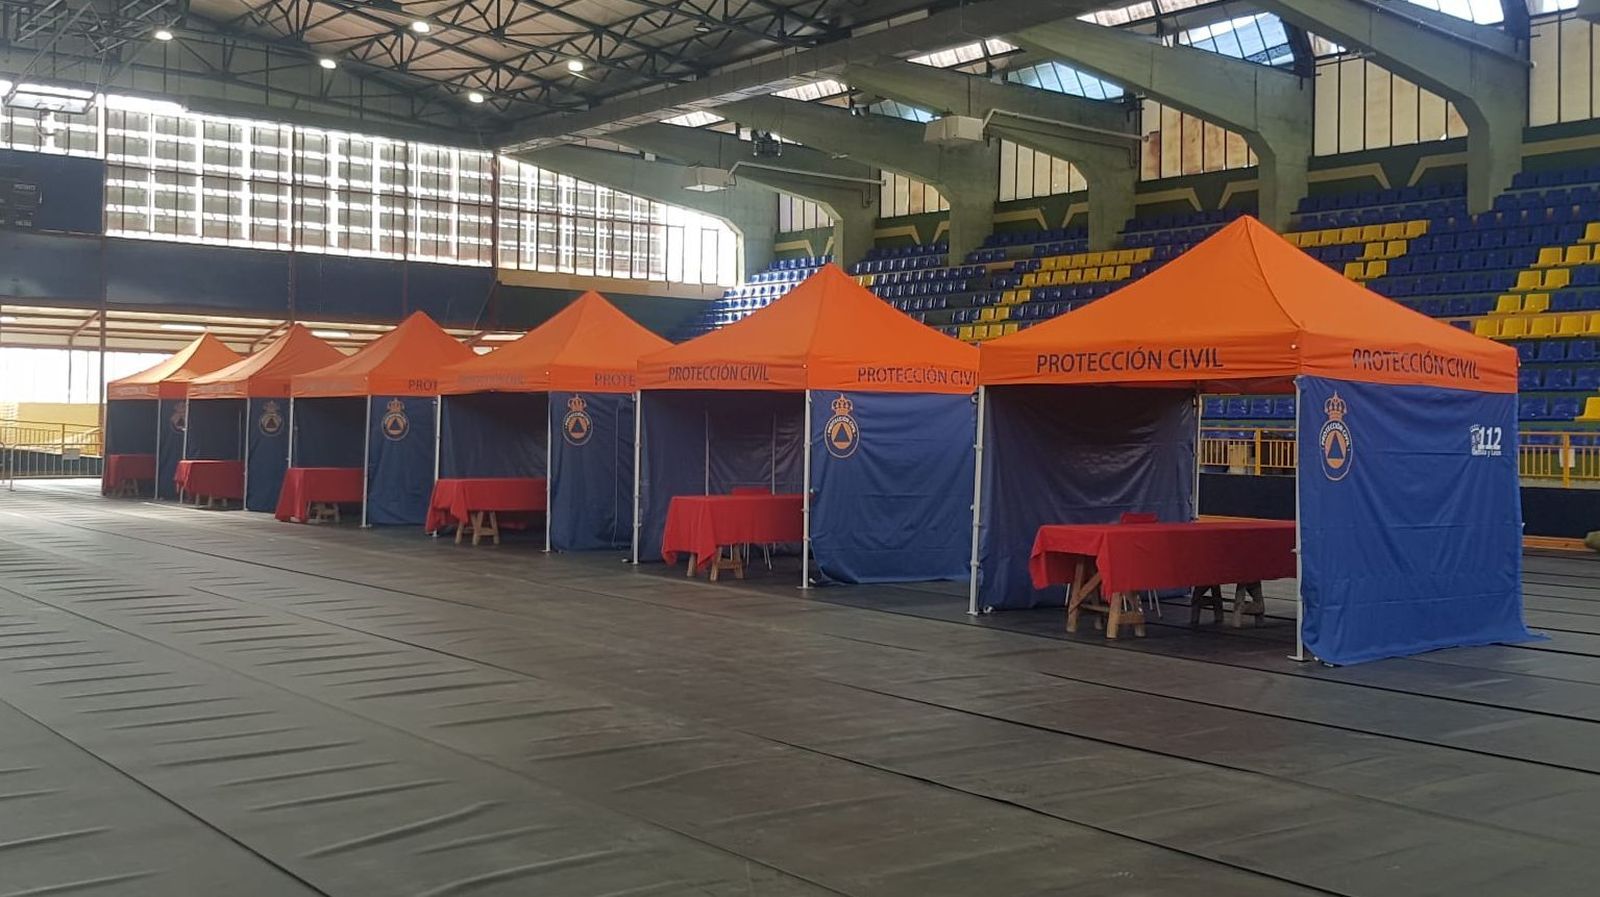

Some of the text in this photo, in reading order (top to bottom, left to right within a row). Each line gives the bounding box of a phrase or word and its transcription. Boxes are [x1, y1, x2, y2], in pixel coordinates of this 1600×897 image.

[1036, 346, 1224, 373] PROTECCIÓN CIVIL
[1352, 348, 1480, 380] PROTECCIÓN CIVIL
[668, 363, 769, 382] PROTECCIÓN CIVIL
[857, 365, 948, 384] PROTECCIÓN
[1478, 426, 1502, 450] 112
